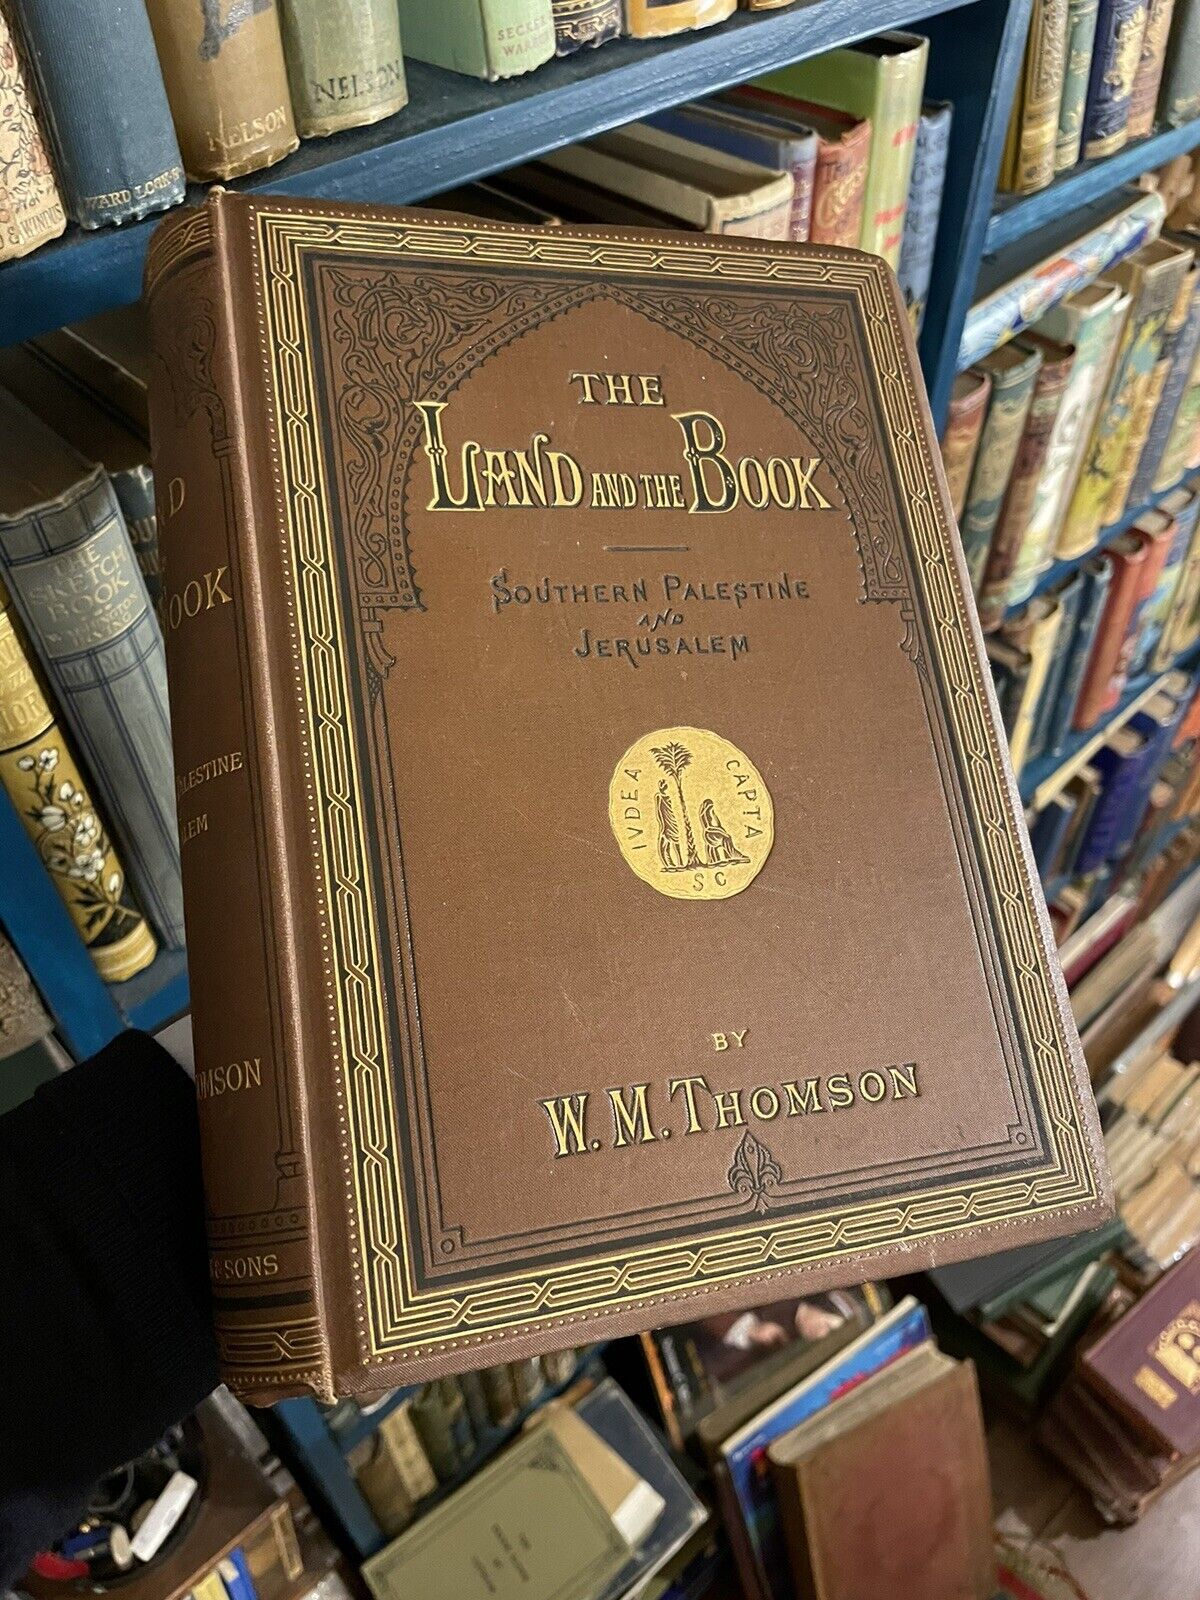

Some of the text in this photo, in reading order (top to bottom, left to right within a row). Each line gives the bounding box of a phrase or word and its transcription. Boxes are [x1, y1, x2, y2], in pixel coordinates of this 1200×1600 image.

[310, 59, 400, 102] NELSON
[206, 105, 289, 152] NELSON
[20, 203, 65, 239] WINDUS
[86, 189, 132, 210] WARD
[571, 372, 667, 408] THE
[413, 401, 834, 514] LAND AND THE BOOK
[30, 544, 127, 602] SKETCH
[54, 544, 101, 578] THE
[48, 570, 130, 622] BOOK
[168, 566, 233, 629] OOK
[490, 567, 810, 612] SOUTHERN PALESTINE
[639, 609, 684, 631] AND
[575, 630, 750, 668] JERUSALEM
[621, 769, 647, 850] IVDEA
[726, 759, 763, 839] CAPTA
[711, 1029, 748, 1052] BY
[668, 1062, 921, 1136] THOMSON
